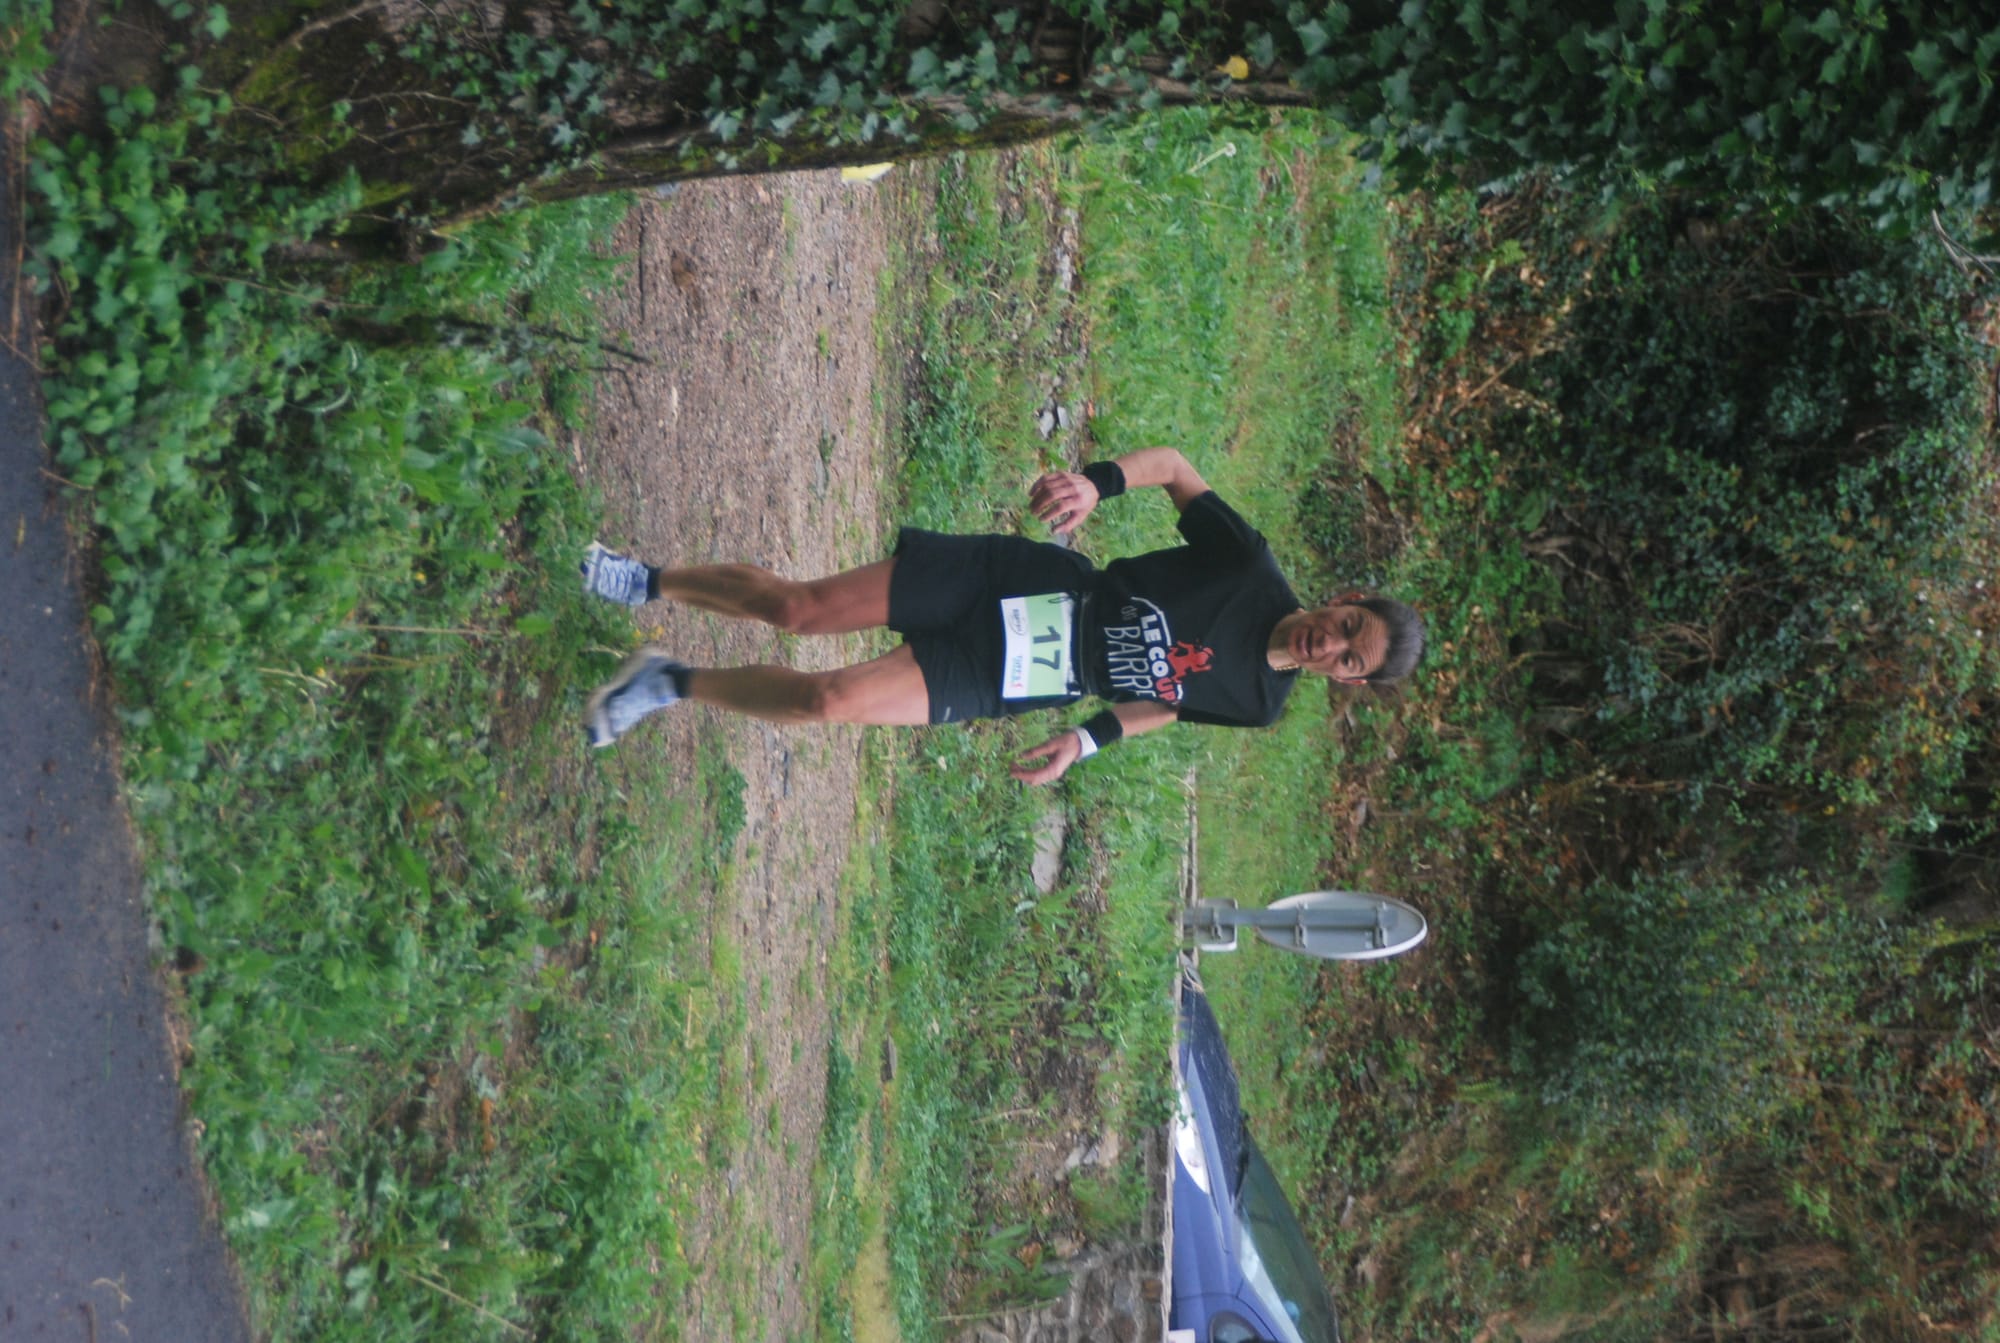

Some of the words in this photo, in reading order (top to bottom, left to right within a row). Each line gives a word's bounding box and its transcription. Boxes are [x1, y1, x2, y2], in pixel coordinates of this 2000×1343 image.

[1032, 625, 1062, 671] 17
[1140, 614, 1162, 643] LE
[1148, 646, 1177, 701] COUP
